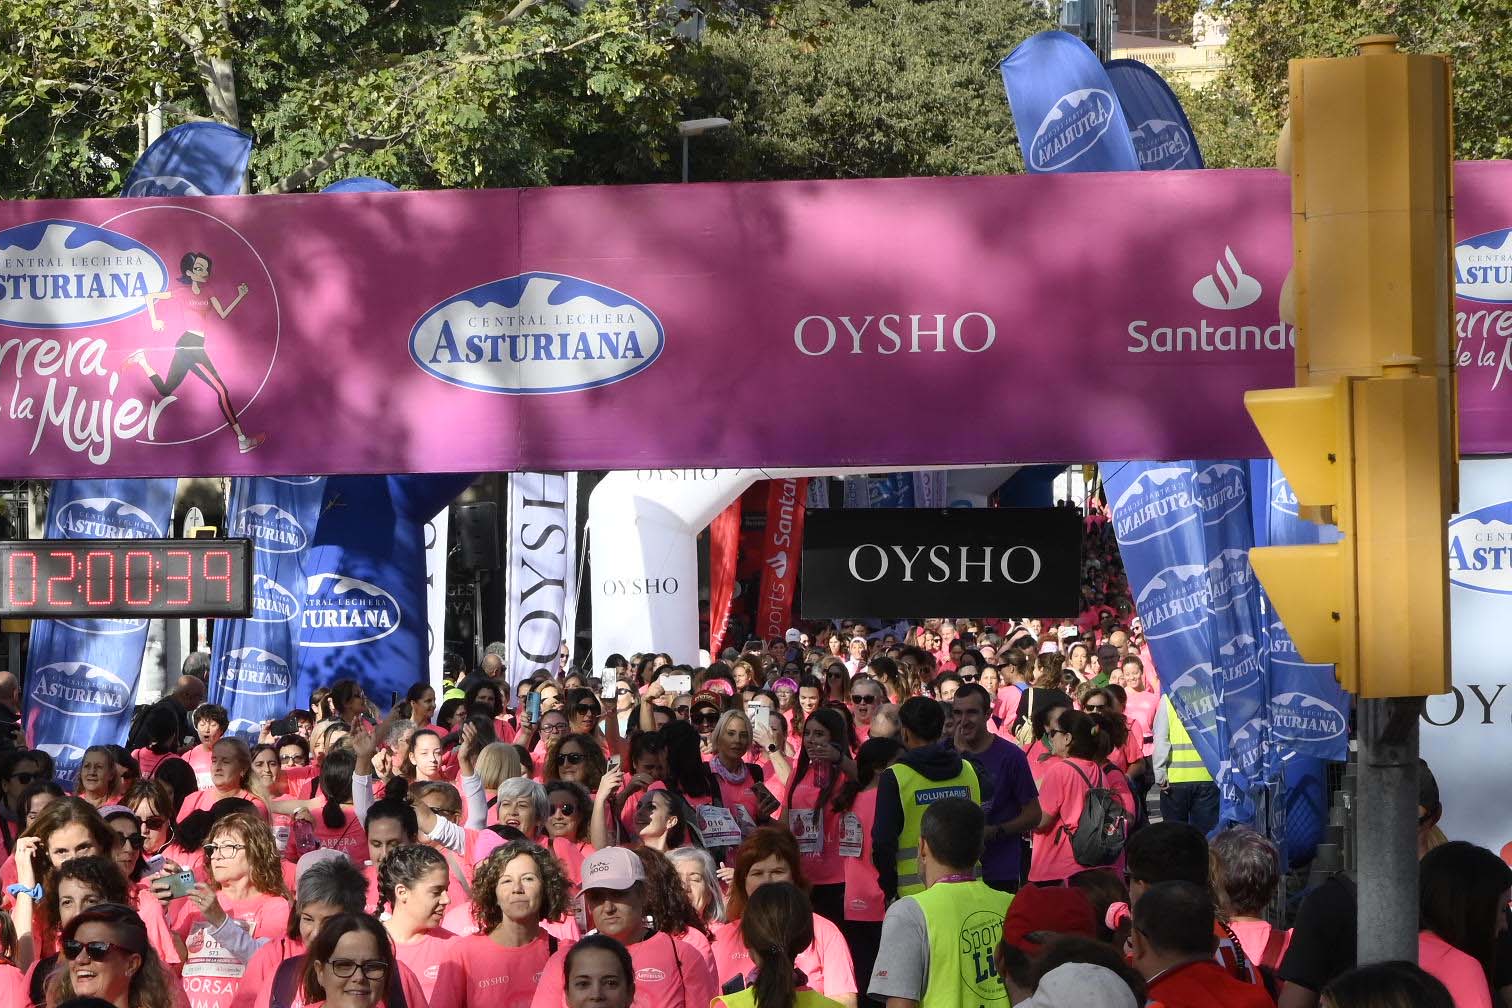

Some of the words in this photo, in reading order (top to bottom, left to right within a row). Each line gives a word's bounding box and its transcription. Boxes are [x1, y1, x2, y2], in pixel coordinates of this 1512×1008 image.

[72, 255, 144, 267] LECHERA
[468, 314, 546, 328] CENTRAL
[554, 313, 636, 325] LECHERA
[794, 312, 997, 356] OYSHO
[429, 319, 644, 364] ASTURIANA
[1478, 340, 1496, 367] la
[9, 380, 35, 420] la
[29, 376, 178, 465] Mujer
[8, 551, 234, 605] 02:00:39
[848, 544, 1041, 584] OYSHO
[603, 577, 679, 596] OYSHO
[33, 677, 123, 709] ASTURIANA
[917, 789, 967, 801] VOLUNTARIS
